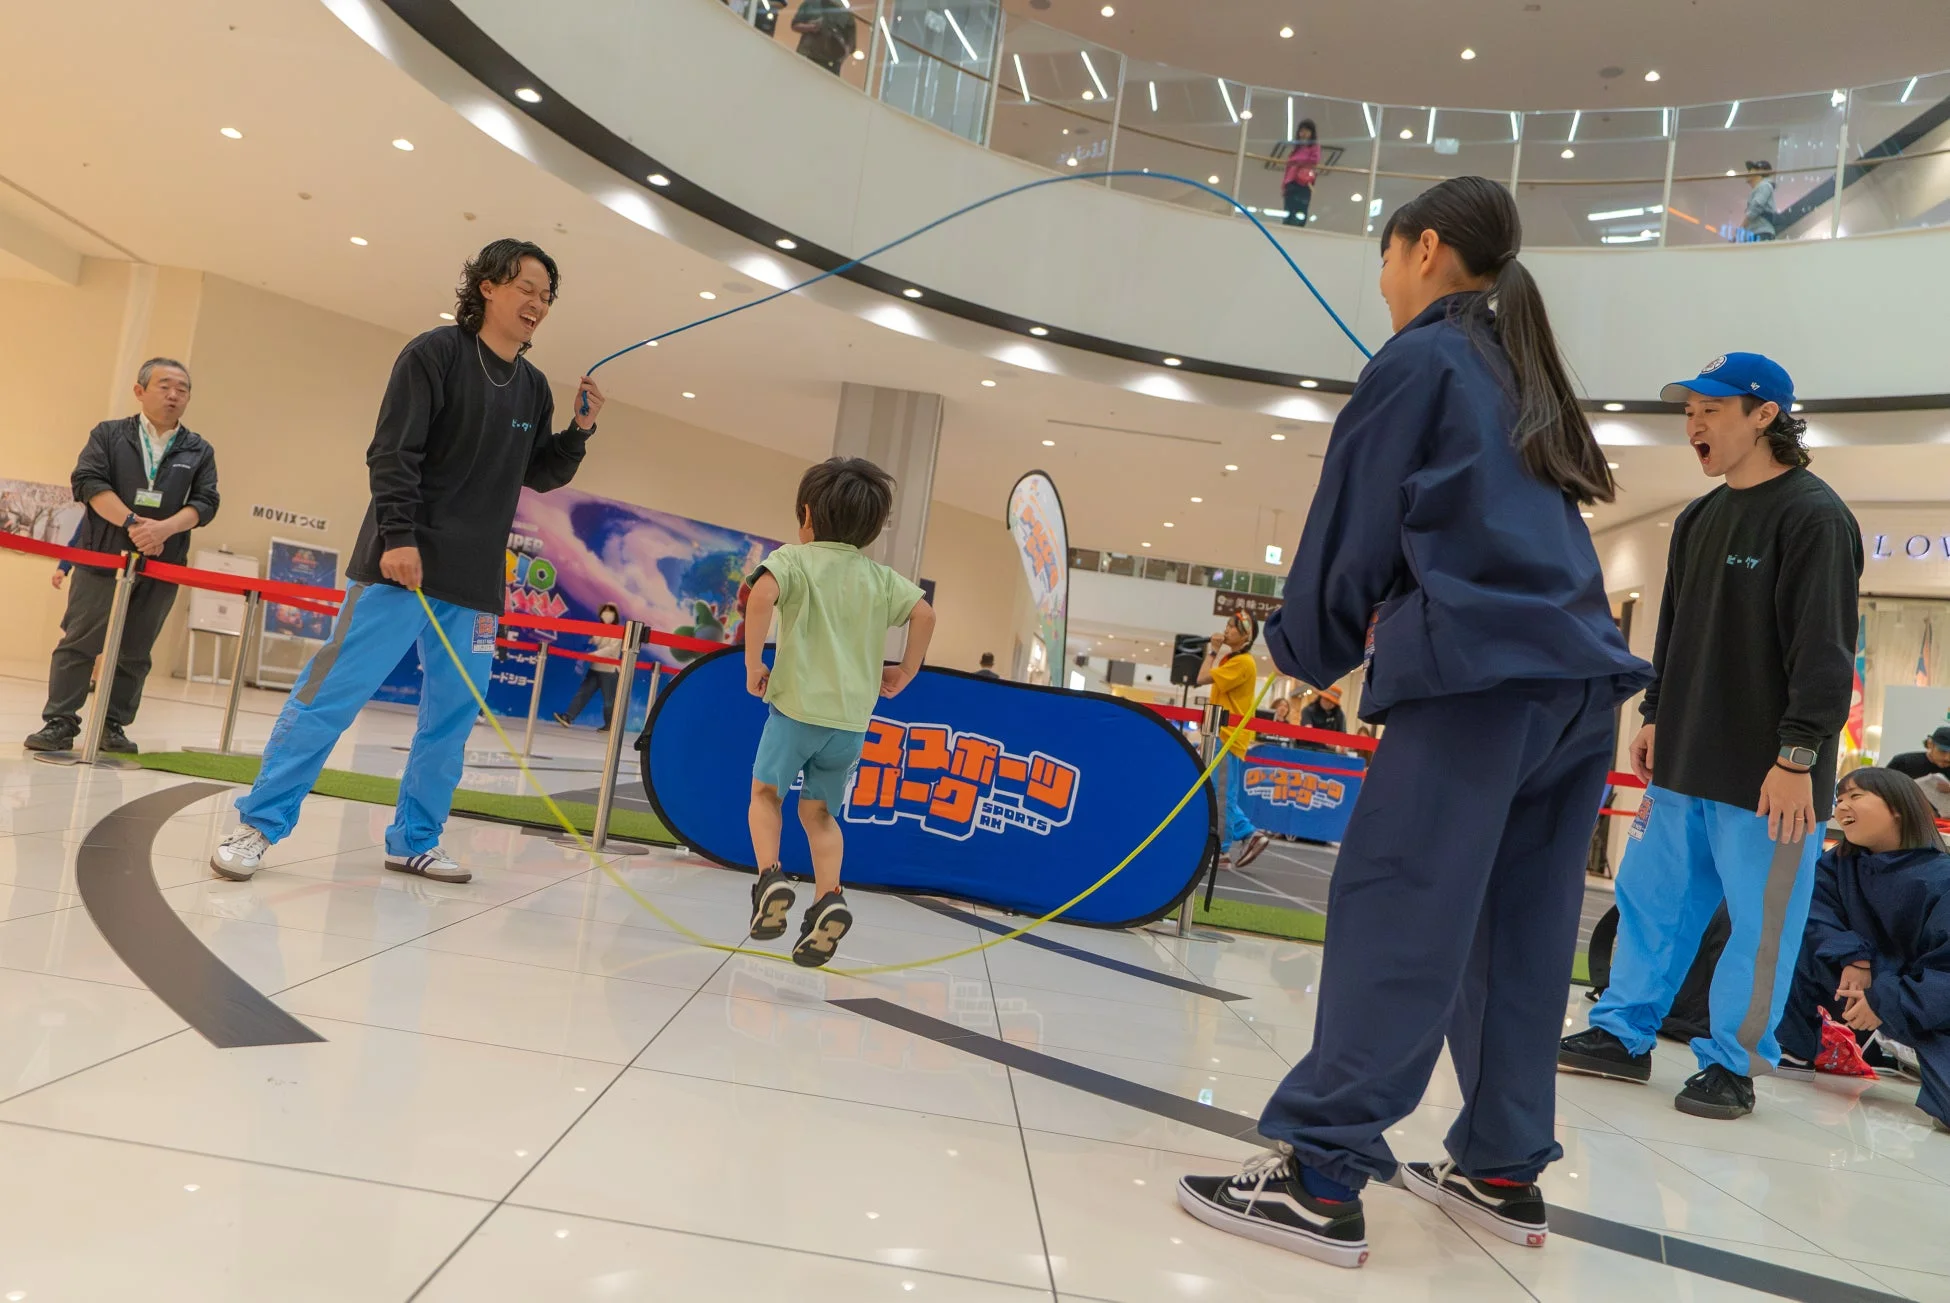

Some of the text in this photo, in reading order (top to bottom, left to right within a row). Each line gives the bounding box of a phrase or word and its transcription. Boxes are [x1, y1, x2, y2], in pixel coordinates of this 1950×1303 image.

[490, 672, 536, 686] ードショー
[852, 766, 978, 824] パーク
[982, 802, 1048, 832] SPORTS
